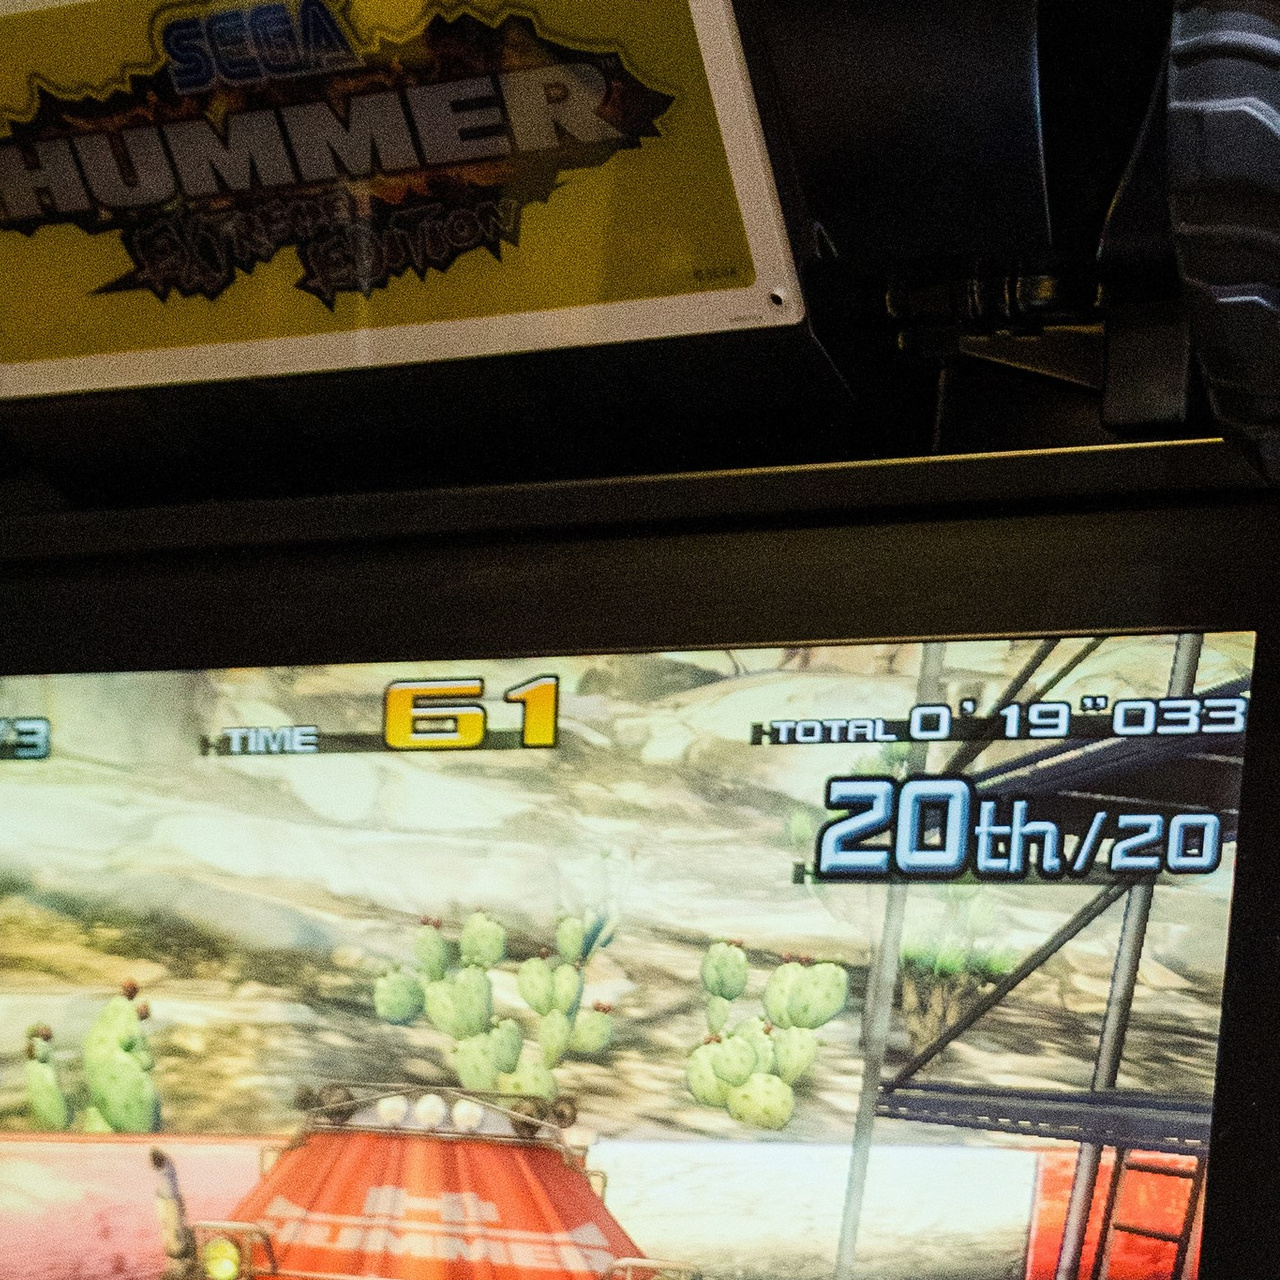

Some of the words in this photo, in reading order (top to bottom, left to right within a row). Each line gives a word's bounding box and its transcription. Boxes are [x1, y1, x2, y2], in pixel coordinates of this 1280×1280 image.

[163, 0, 366, 95] SEGA
[304, 198, 518, 290] EDITION
[224, 726, 318, 752] TIME
[384, 675, 558, 750] 61
[772, 717, 896, 744] TOTAL
